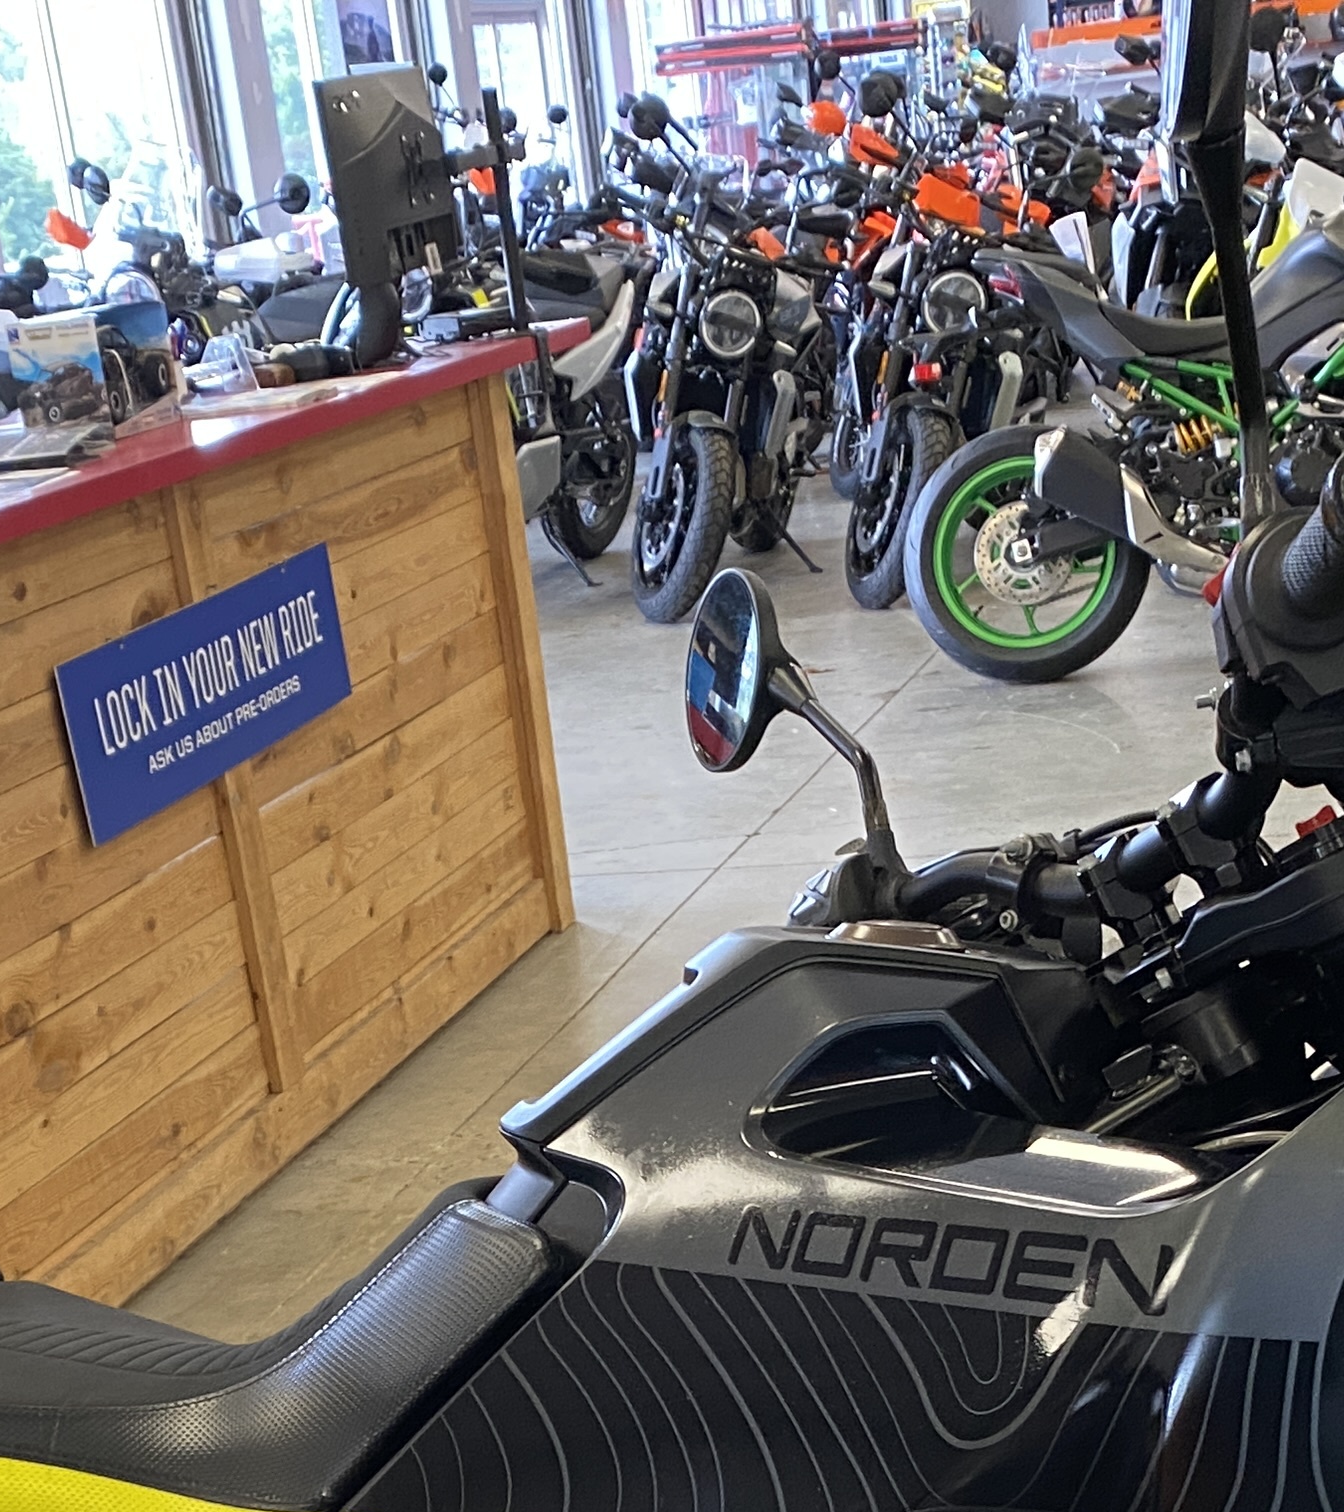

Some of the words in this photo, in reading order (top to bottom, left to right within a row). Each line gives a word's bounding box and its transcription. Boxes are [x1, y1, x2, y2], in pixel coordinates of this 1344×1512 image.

[94, 675, 157, 756] LOCK
[153, 661, 186, 725] IN
[182, 634, 241, 709] YOUR
[237, 612, 281, 682] NEW
[278, 590, 324, 660] RIDE
[149, 749, 176, 774] ASK
[176, 734, 194, 758] US
[195, 712, 235, 748] ABOUT
[234, 674, 301, 726] PRE-ORDERS
[727, 1204, 1176, 1318] NORDEN
